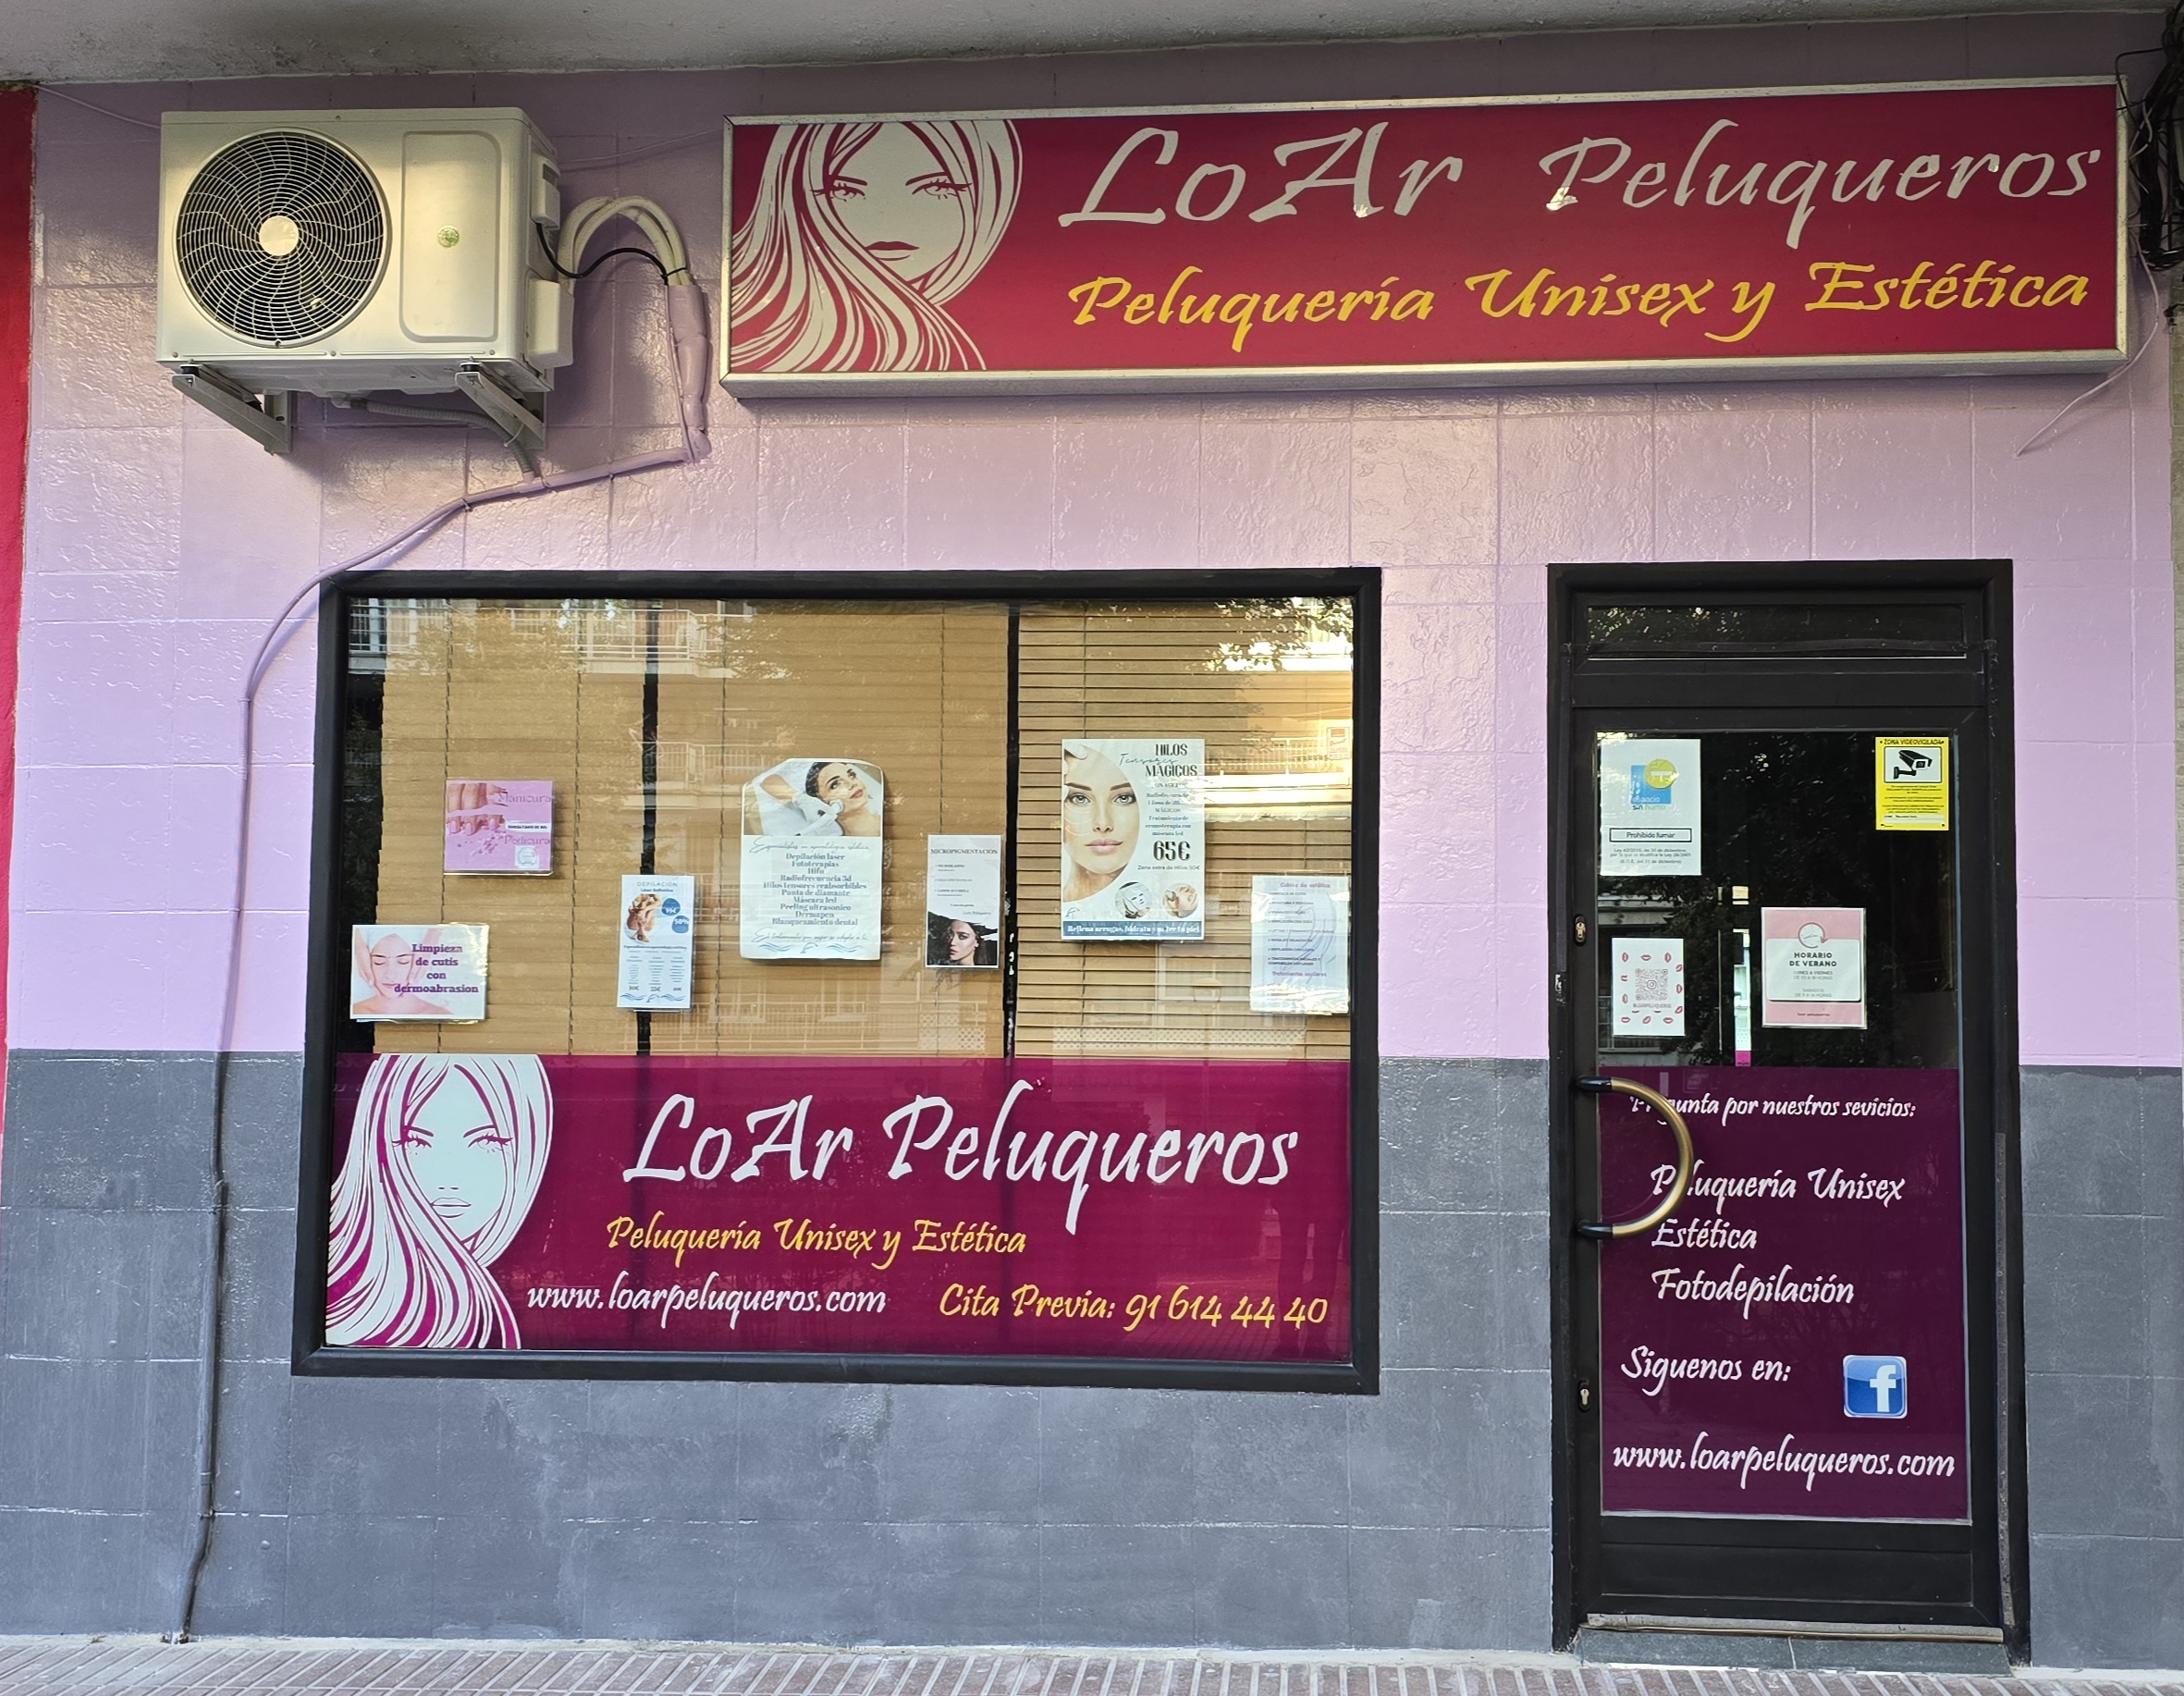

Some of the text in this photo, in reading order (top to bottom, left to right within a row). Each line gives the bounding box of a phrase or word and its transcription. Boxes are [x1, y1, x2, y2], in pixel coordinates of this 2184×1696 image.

[1058, 118, 2101, 249] LoAr Peluqueros
[1068, 260, 2089, 352] Peluquería Unisex y Estética
[1155, 744, 1188, 756] HILOS
[1153, 841, 1191, 861] 65€
[411, 944, 463, 954] Limpieza
[415, 957, 459, 966] de cutis
[394, 984, 479, 993] dermoabrasion
[1722, 1097, 1759, 1126] por
[1761, 1094, 1840, 1117] nuestros
[1842, 1097, 1916, 1118] sevicios:
[623, 1079, 1298, 1235] LoAr Peluqueros
[1650, 1159, 1905, 1215] Pluquería Unisex
[607, 1211, 1026, 1271] Peluquería Unisex y Estética
[1651, 1217, 1757, 1248] Estética
[527, 1271, 886, 1330] www.loarpeluqueros.com
[939, 1283, 1328, 1332] Cita Previa: 91 614 44 40
[1651, 1263, 1854, 1320] Fotodepilación
[1620, 1345, 1791, 1396] Siguenos en:
[1613, 1431, 1956, 1491] www.loarpeluqueros.com
